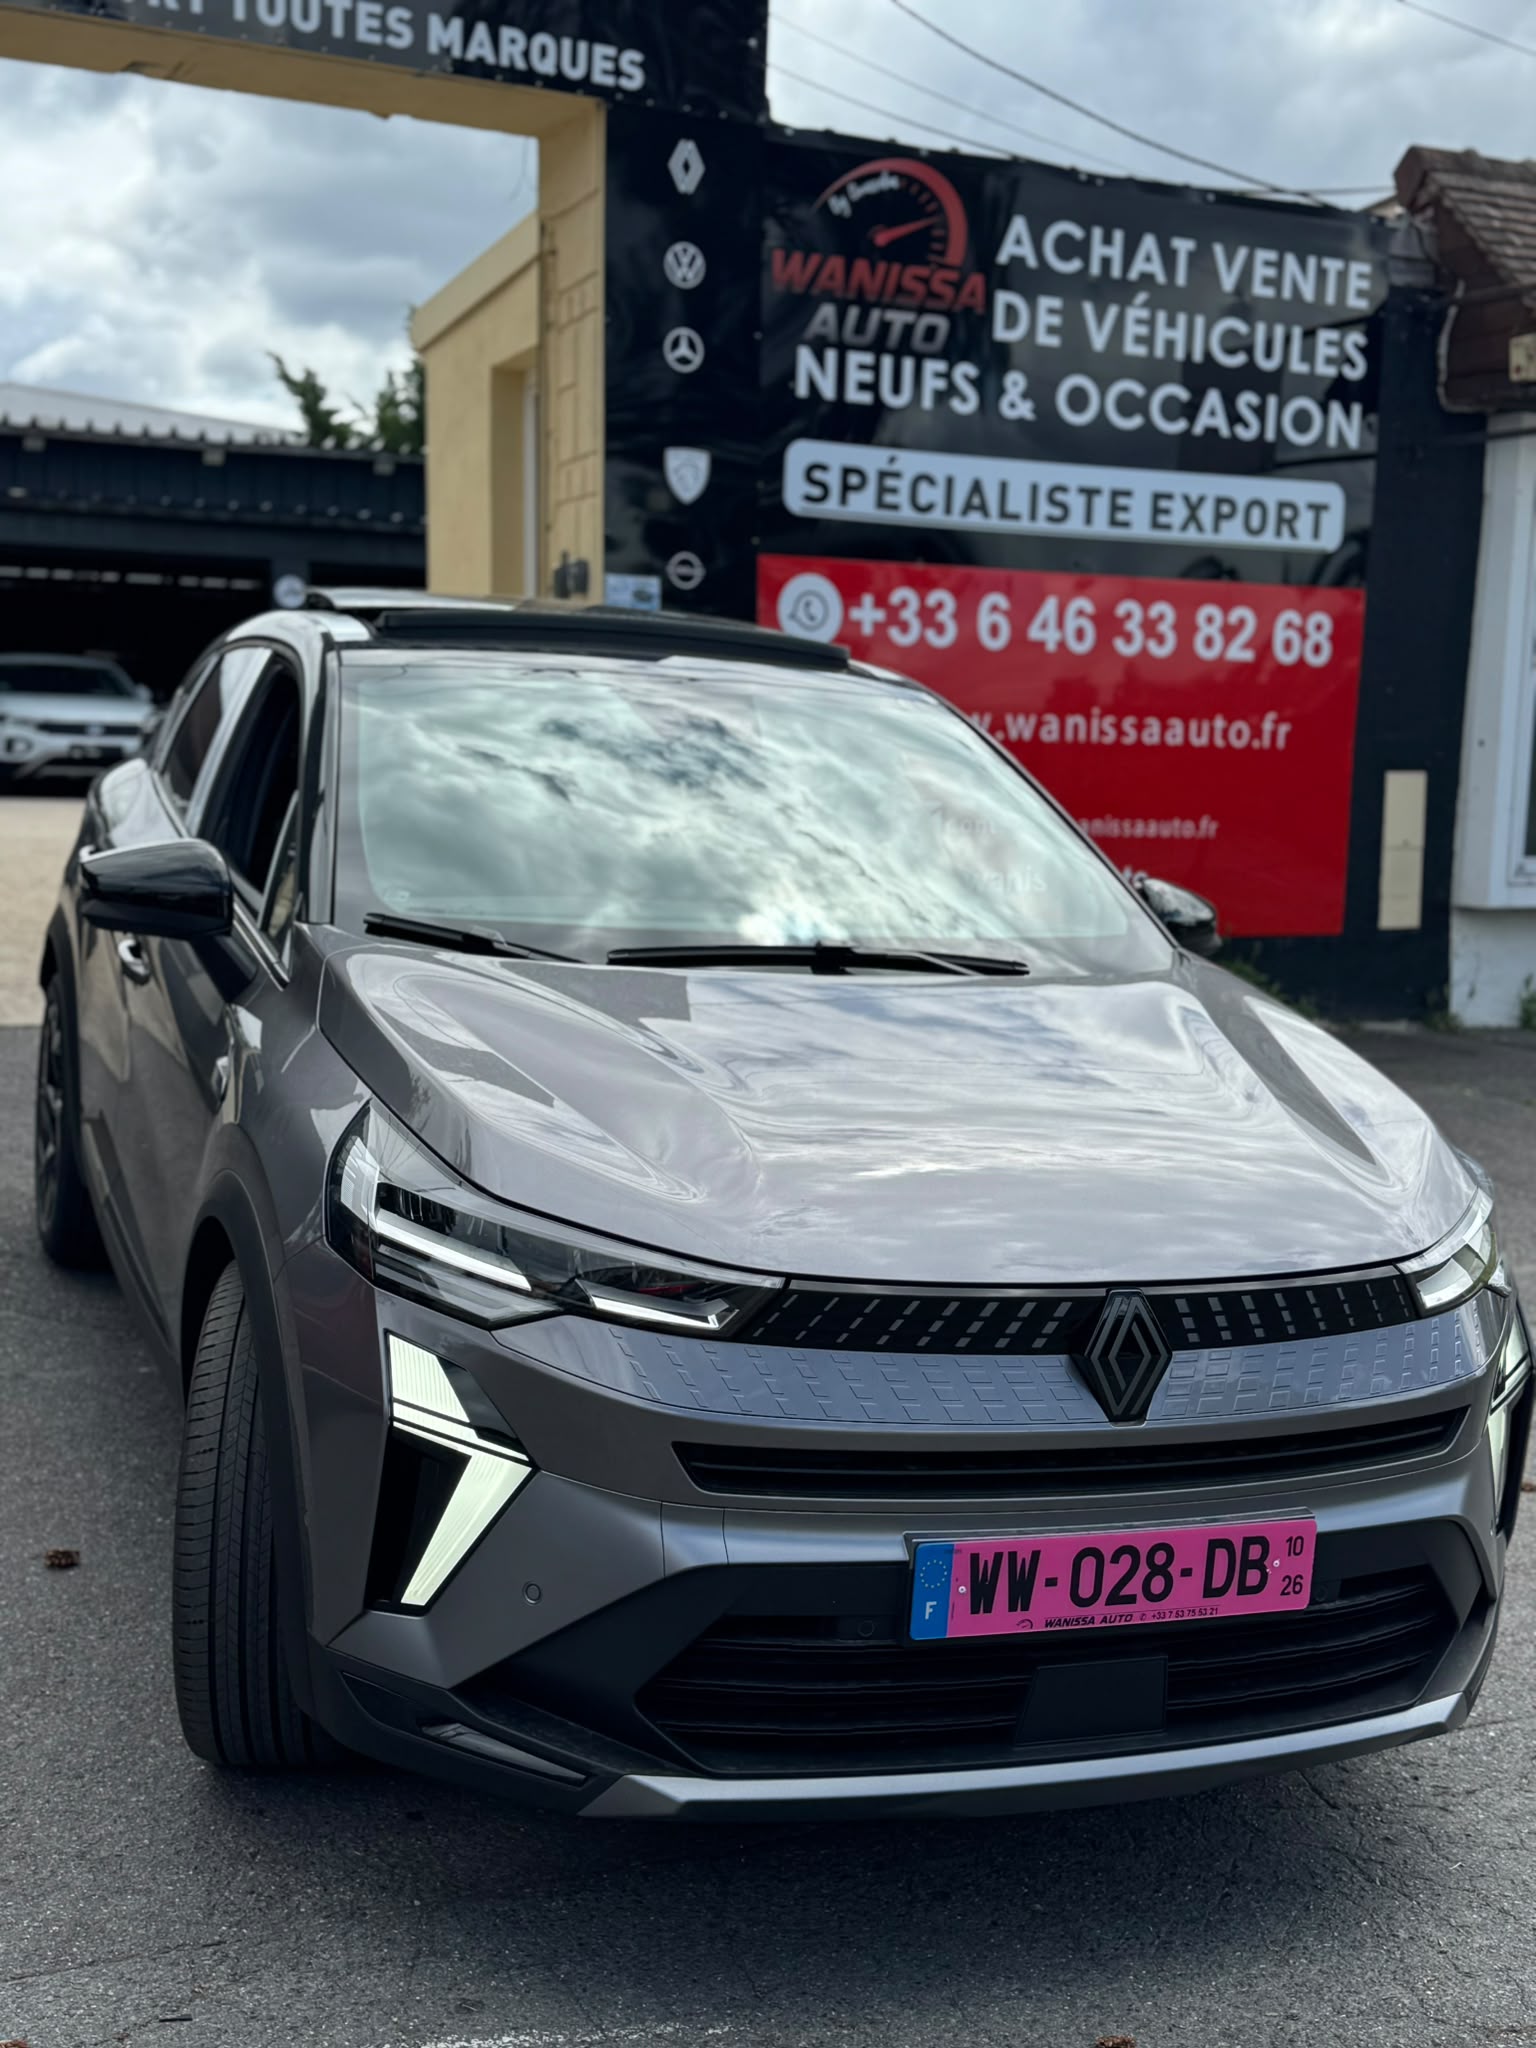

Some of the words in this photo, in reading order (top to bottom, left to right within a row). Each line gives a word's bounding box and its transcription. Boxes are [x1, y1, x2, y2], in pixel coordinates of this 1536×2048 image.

[427, 12, 646, 91] MARQUES
[771, 248, 987, 314] WANISSA
[996, 214, 1197, 288] ACHAT
[1212, 242, 1373, 310] VENTE
[803, 302, 951, 353] AUTO
[992, 289, 1064, 348] DE
[1082, 291, 1369, 381] VÉHICULES
[794, 344, 980, 415] NEUFS
[999, 371, 1036, 421] &
[1055, 373, 1363, 450] OCCASION
[802, 457, 1134, 528] SPÉCIALISTE
[1149, 492, 1331, 541] EXPORT
[849, 586, 959, 648] +33
[976, 592, 1011, 651] 6
[1027, 595, 1097, 656] 46
[1113, 599, 1178, 658] 33
[1193, 604, 1257, 662] 82
[1272, 609, 1335, 668] 68
[925, 1601, 937, 1620] F
[970, 1535, 1271, 1615] WW-028-DB
[1286, 1535, 1304, 1557] 10
[1280, 1574, 1304, 1596] 26
[1045, 1615, 1096, 1629] WANISSA
[1100, 1613, 1133, 1625] AUTO
[1152, 1610, 1166, 1621] +33
[1168, 1610, 1173, 1619] 7
